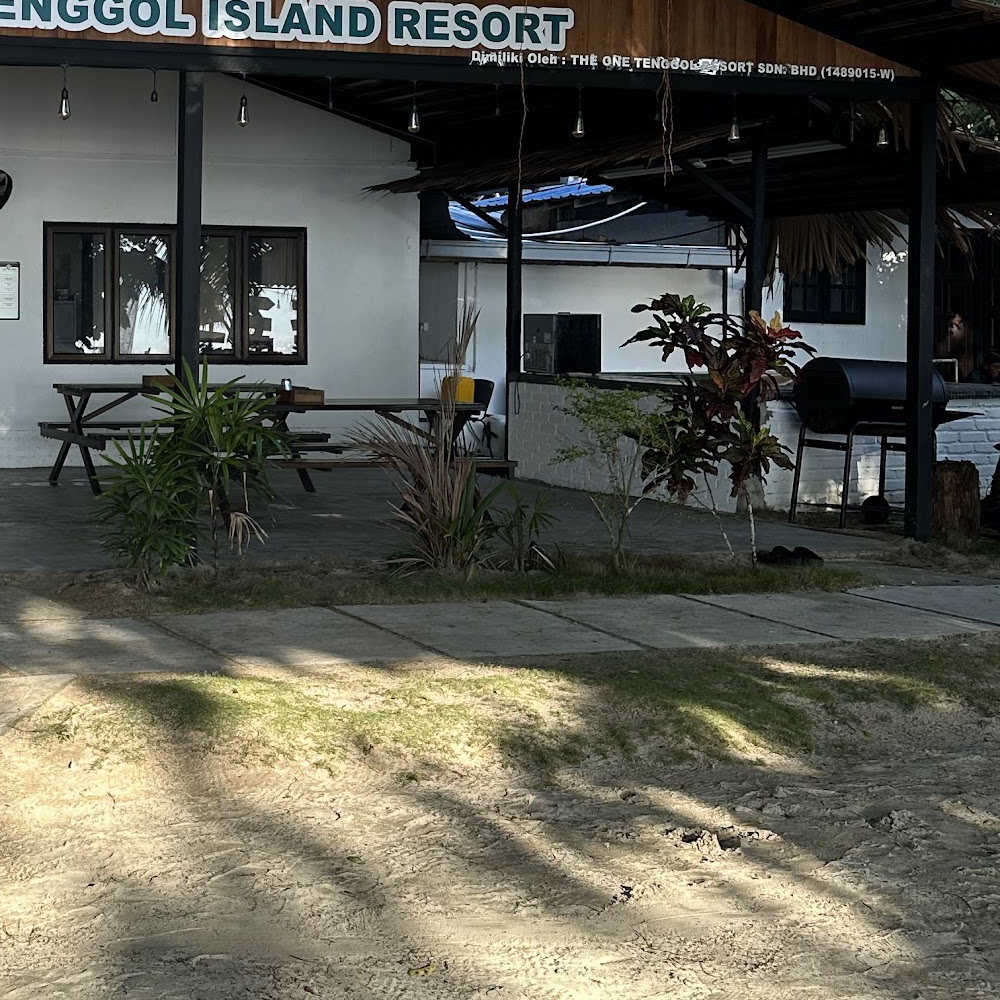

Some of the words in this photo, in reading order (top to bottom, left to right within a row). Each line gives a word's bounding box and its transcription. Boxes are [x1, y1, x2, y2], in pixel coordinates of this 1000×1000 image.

[393, 7, 569, 45] RESORT
[570, 54, 598, 67] THE
[602, 55, 631, 68] ONE
[790, 64, 817, 77] BHD
[820, 66, 895, 82] (1489015-W)
